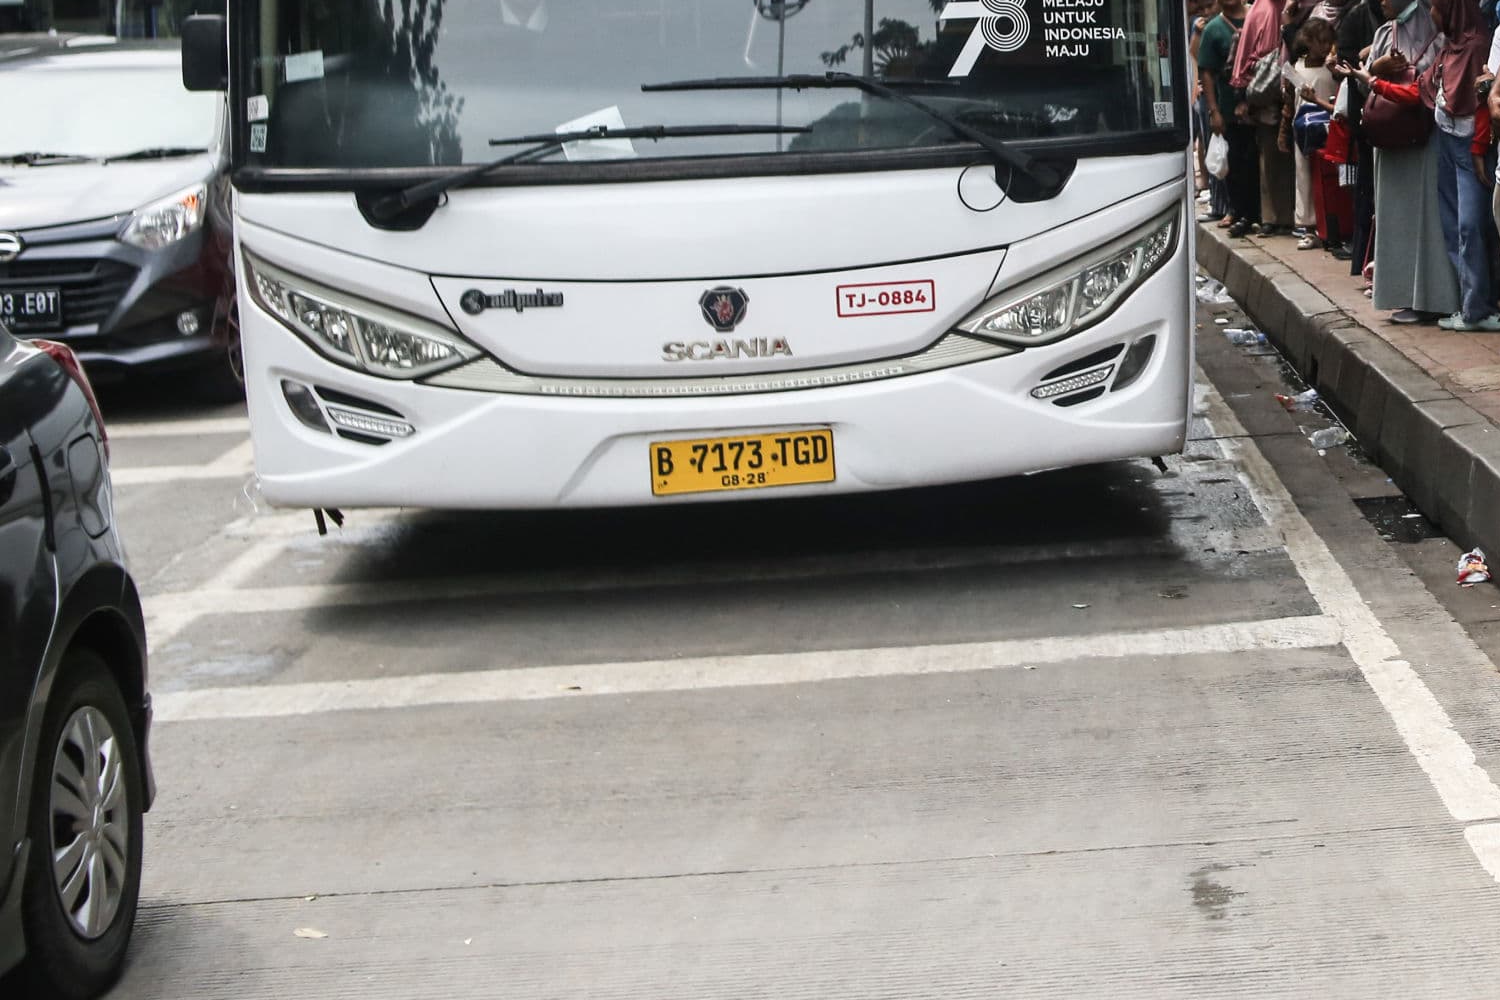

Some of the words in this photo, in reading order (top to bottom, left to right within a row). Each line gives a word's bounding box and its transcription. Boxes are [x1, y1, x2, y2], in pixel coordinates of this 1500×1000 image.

[1043, 11, 1097, 24] UNTUK
[1044, 27, 1126, 41] INDONESIA
[1046, 45, 1090, 58] MAJU
[845, 289, 927, 308] TJ-0884
[661, 335, 793, 362] SCANIA
[656, 447, 674, 477] B
[691, 440, 763, 473] 7173
[775, 435, 828, 467] TGD
